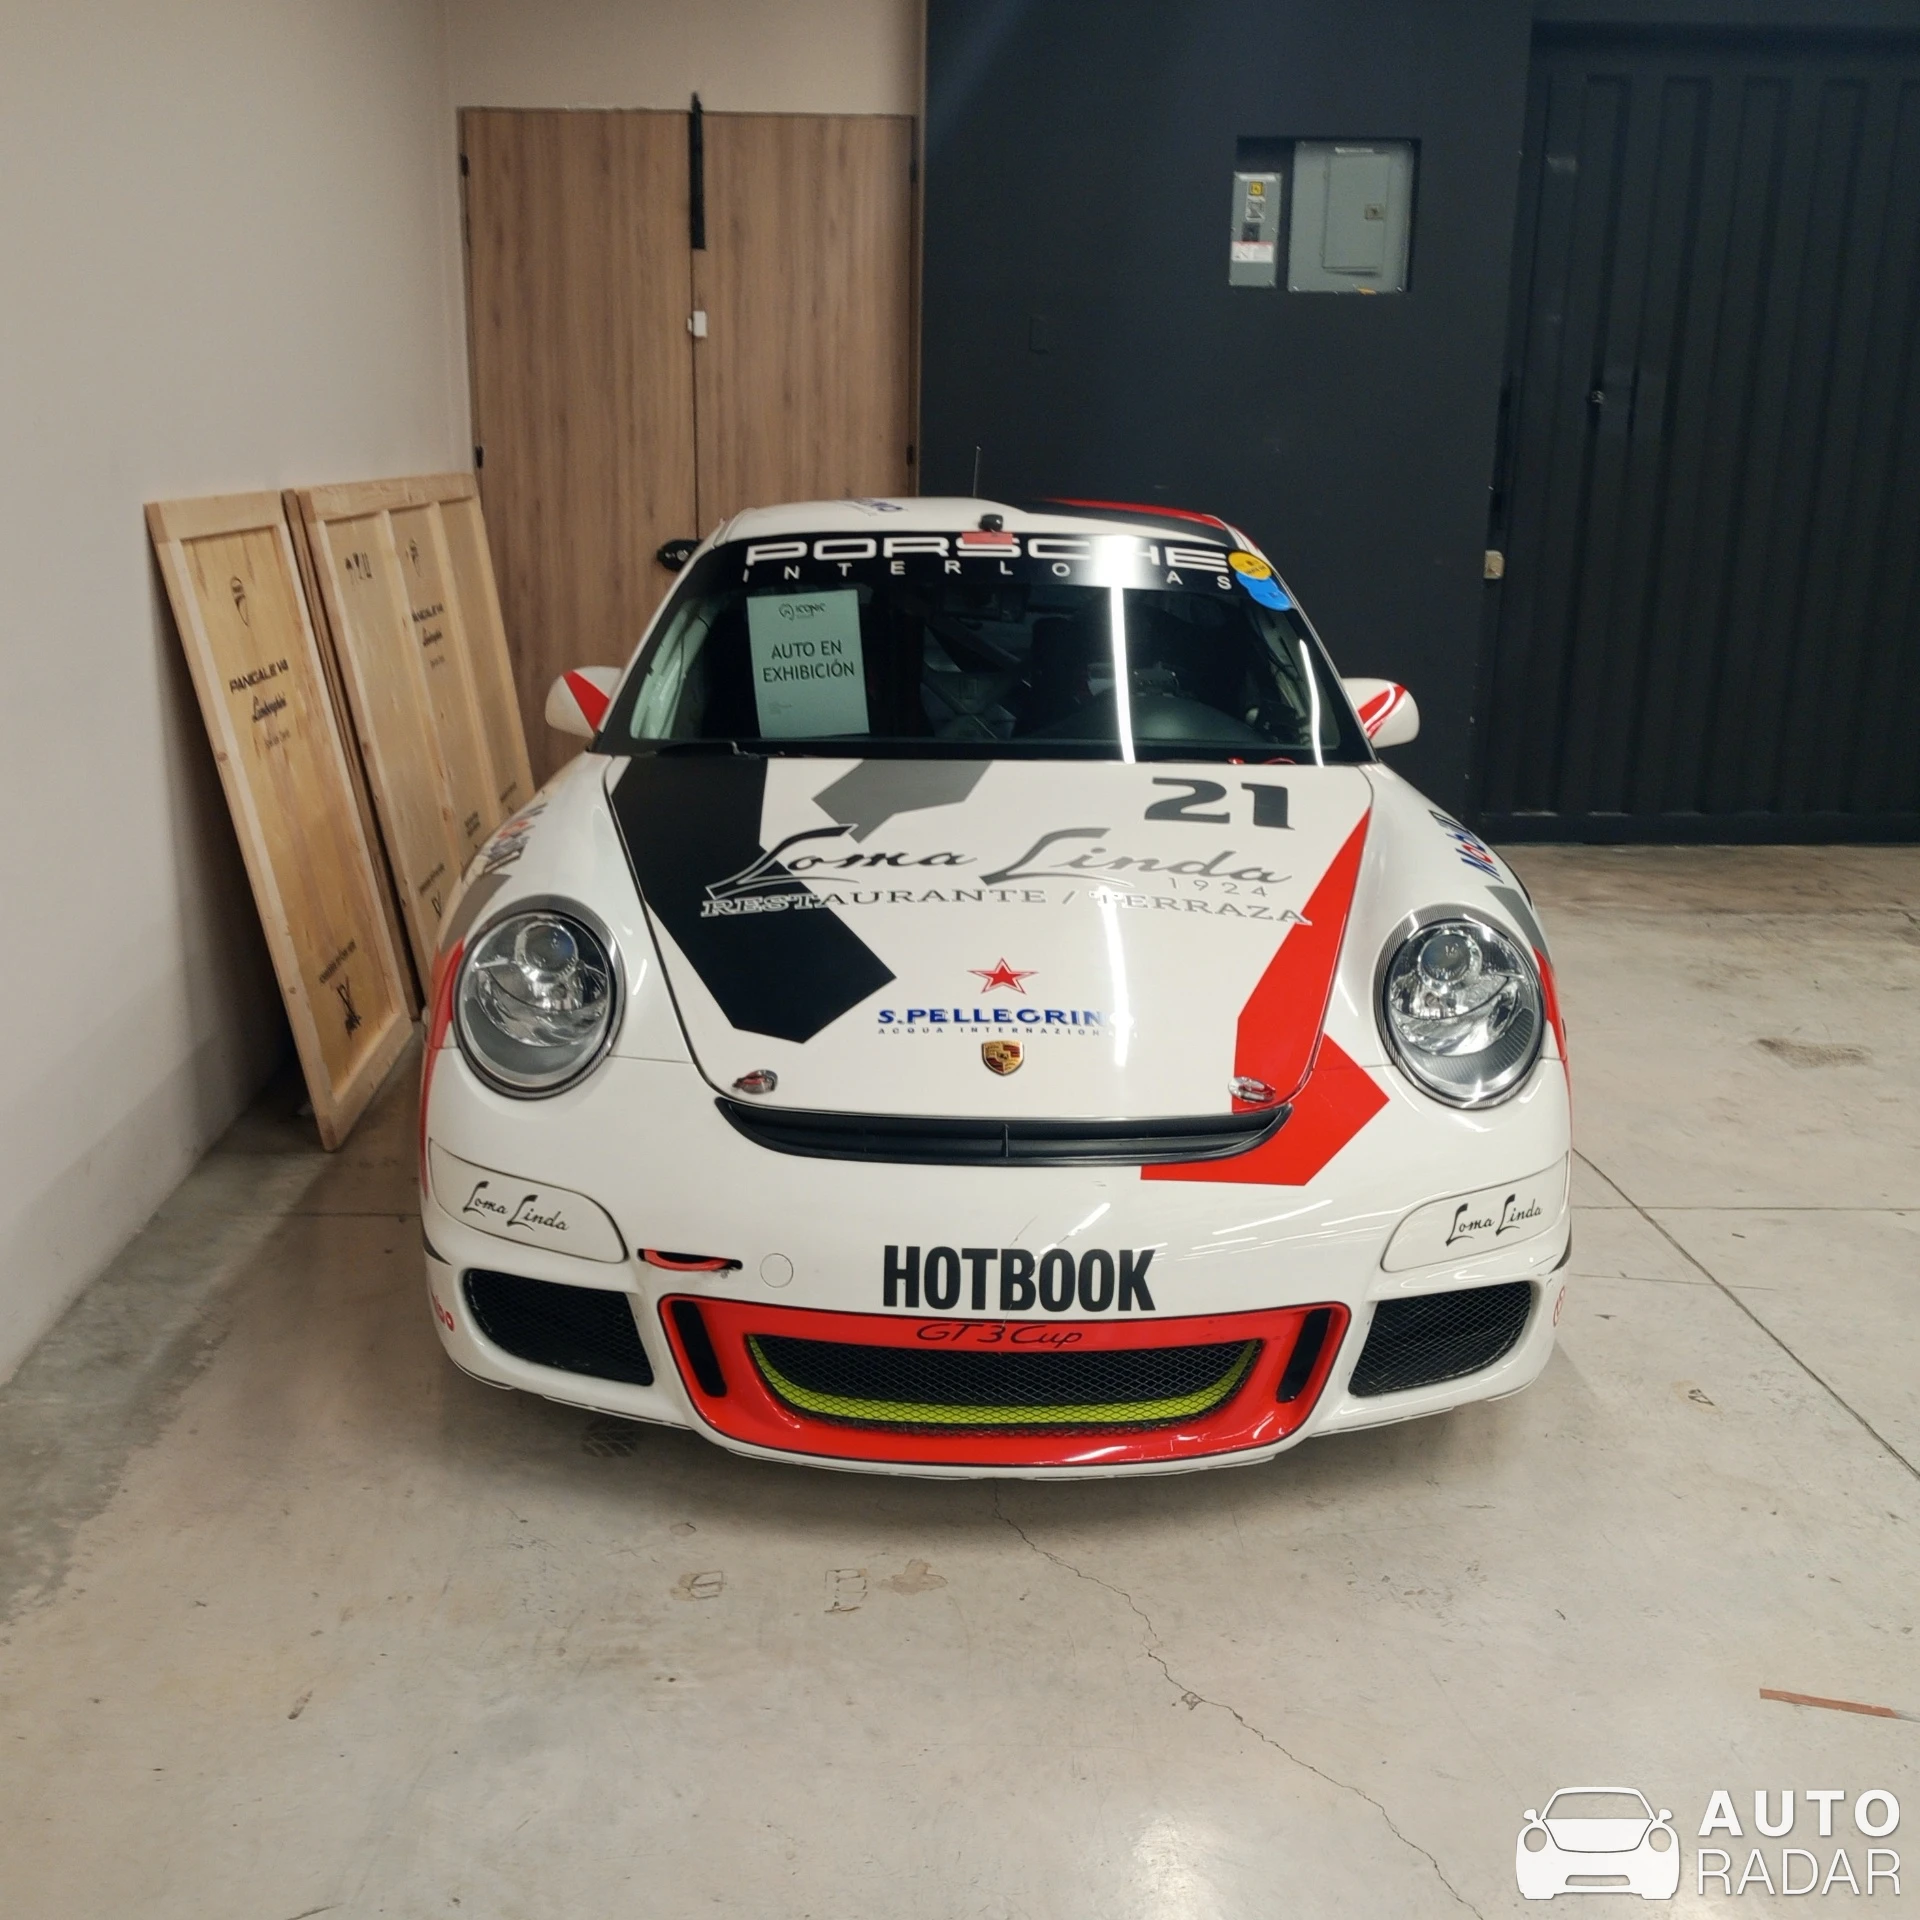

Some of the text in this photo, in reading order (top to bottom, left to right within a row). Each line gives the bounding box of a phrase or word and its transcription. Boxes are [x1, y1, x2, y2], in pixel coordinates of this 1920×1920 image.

[743, 559, 1232, 590] INTERLOAS
[771, 639, 843, 660] AUTO EN
[763, 658, 855, 683] EXHIBICIÓN
[1144, 777, 1296, 830] 21
[705, 823, 1292, 900] Loma Linda
[1168, 877, 1268, 898] 1924
[700, 889, 1046, 918] RESTAURANTE
[1089, 889, 1313, 926] TERRAZA
[877, 1008, 1135, 1028] S.PELLEGRIN
[878, 1027, 944, 1035] ACQUA
[463, 1181, 569, 1232] Loma Linda
[1445, 1193, 1543, 1247] Loma Linda
[883, 1245, 1156, 1312] HOTBOOK
[1010, 1325, 1083, 1348] Cup
